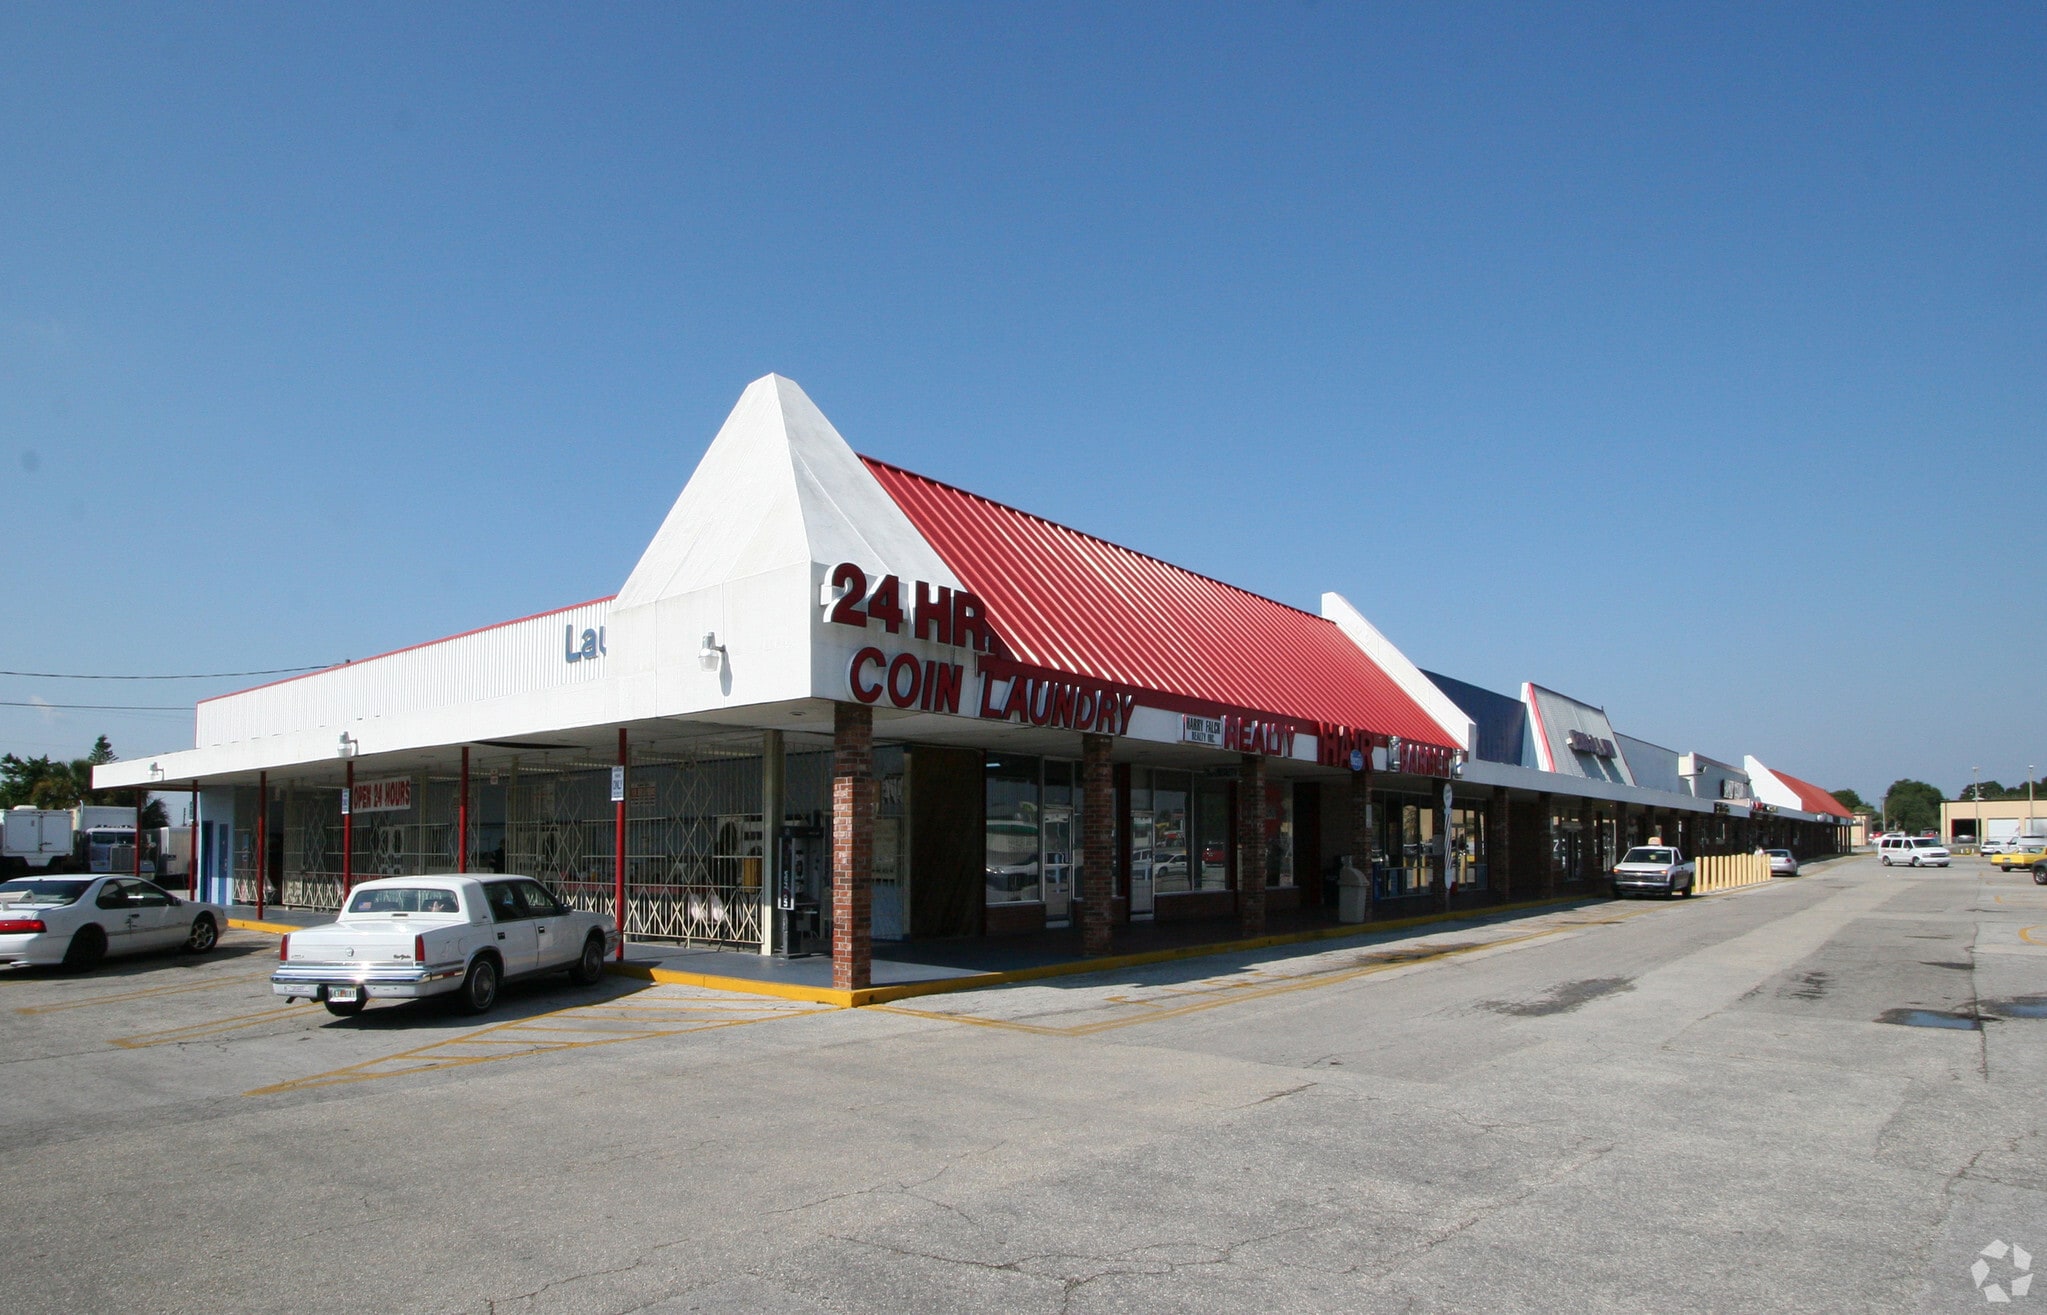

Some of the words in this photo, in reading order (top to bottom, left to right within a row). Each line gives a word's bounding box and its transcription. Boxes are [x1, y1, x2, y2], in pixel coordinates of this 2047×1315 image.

[828, 562, 903, 635] 24
[849, 647, 964, 714] COIN
[979, 671, 1136, 736] LAUNDRY
[1223, 714, 1296, 758] REALTY
[1318, 721, 1375, 771] HAIR
[353, 785, 372, 809] OPEN
[374, 783, 383, 808] 24
[384, 780, 411, 807] HOURS
